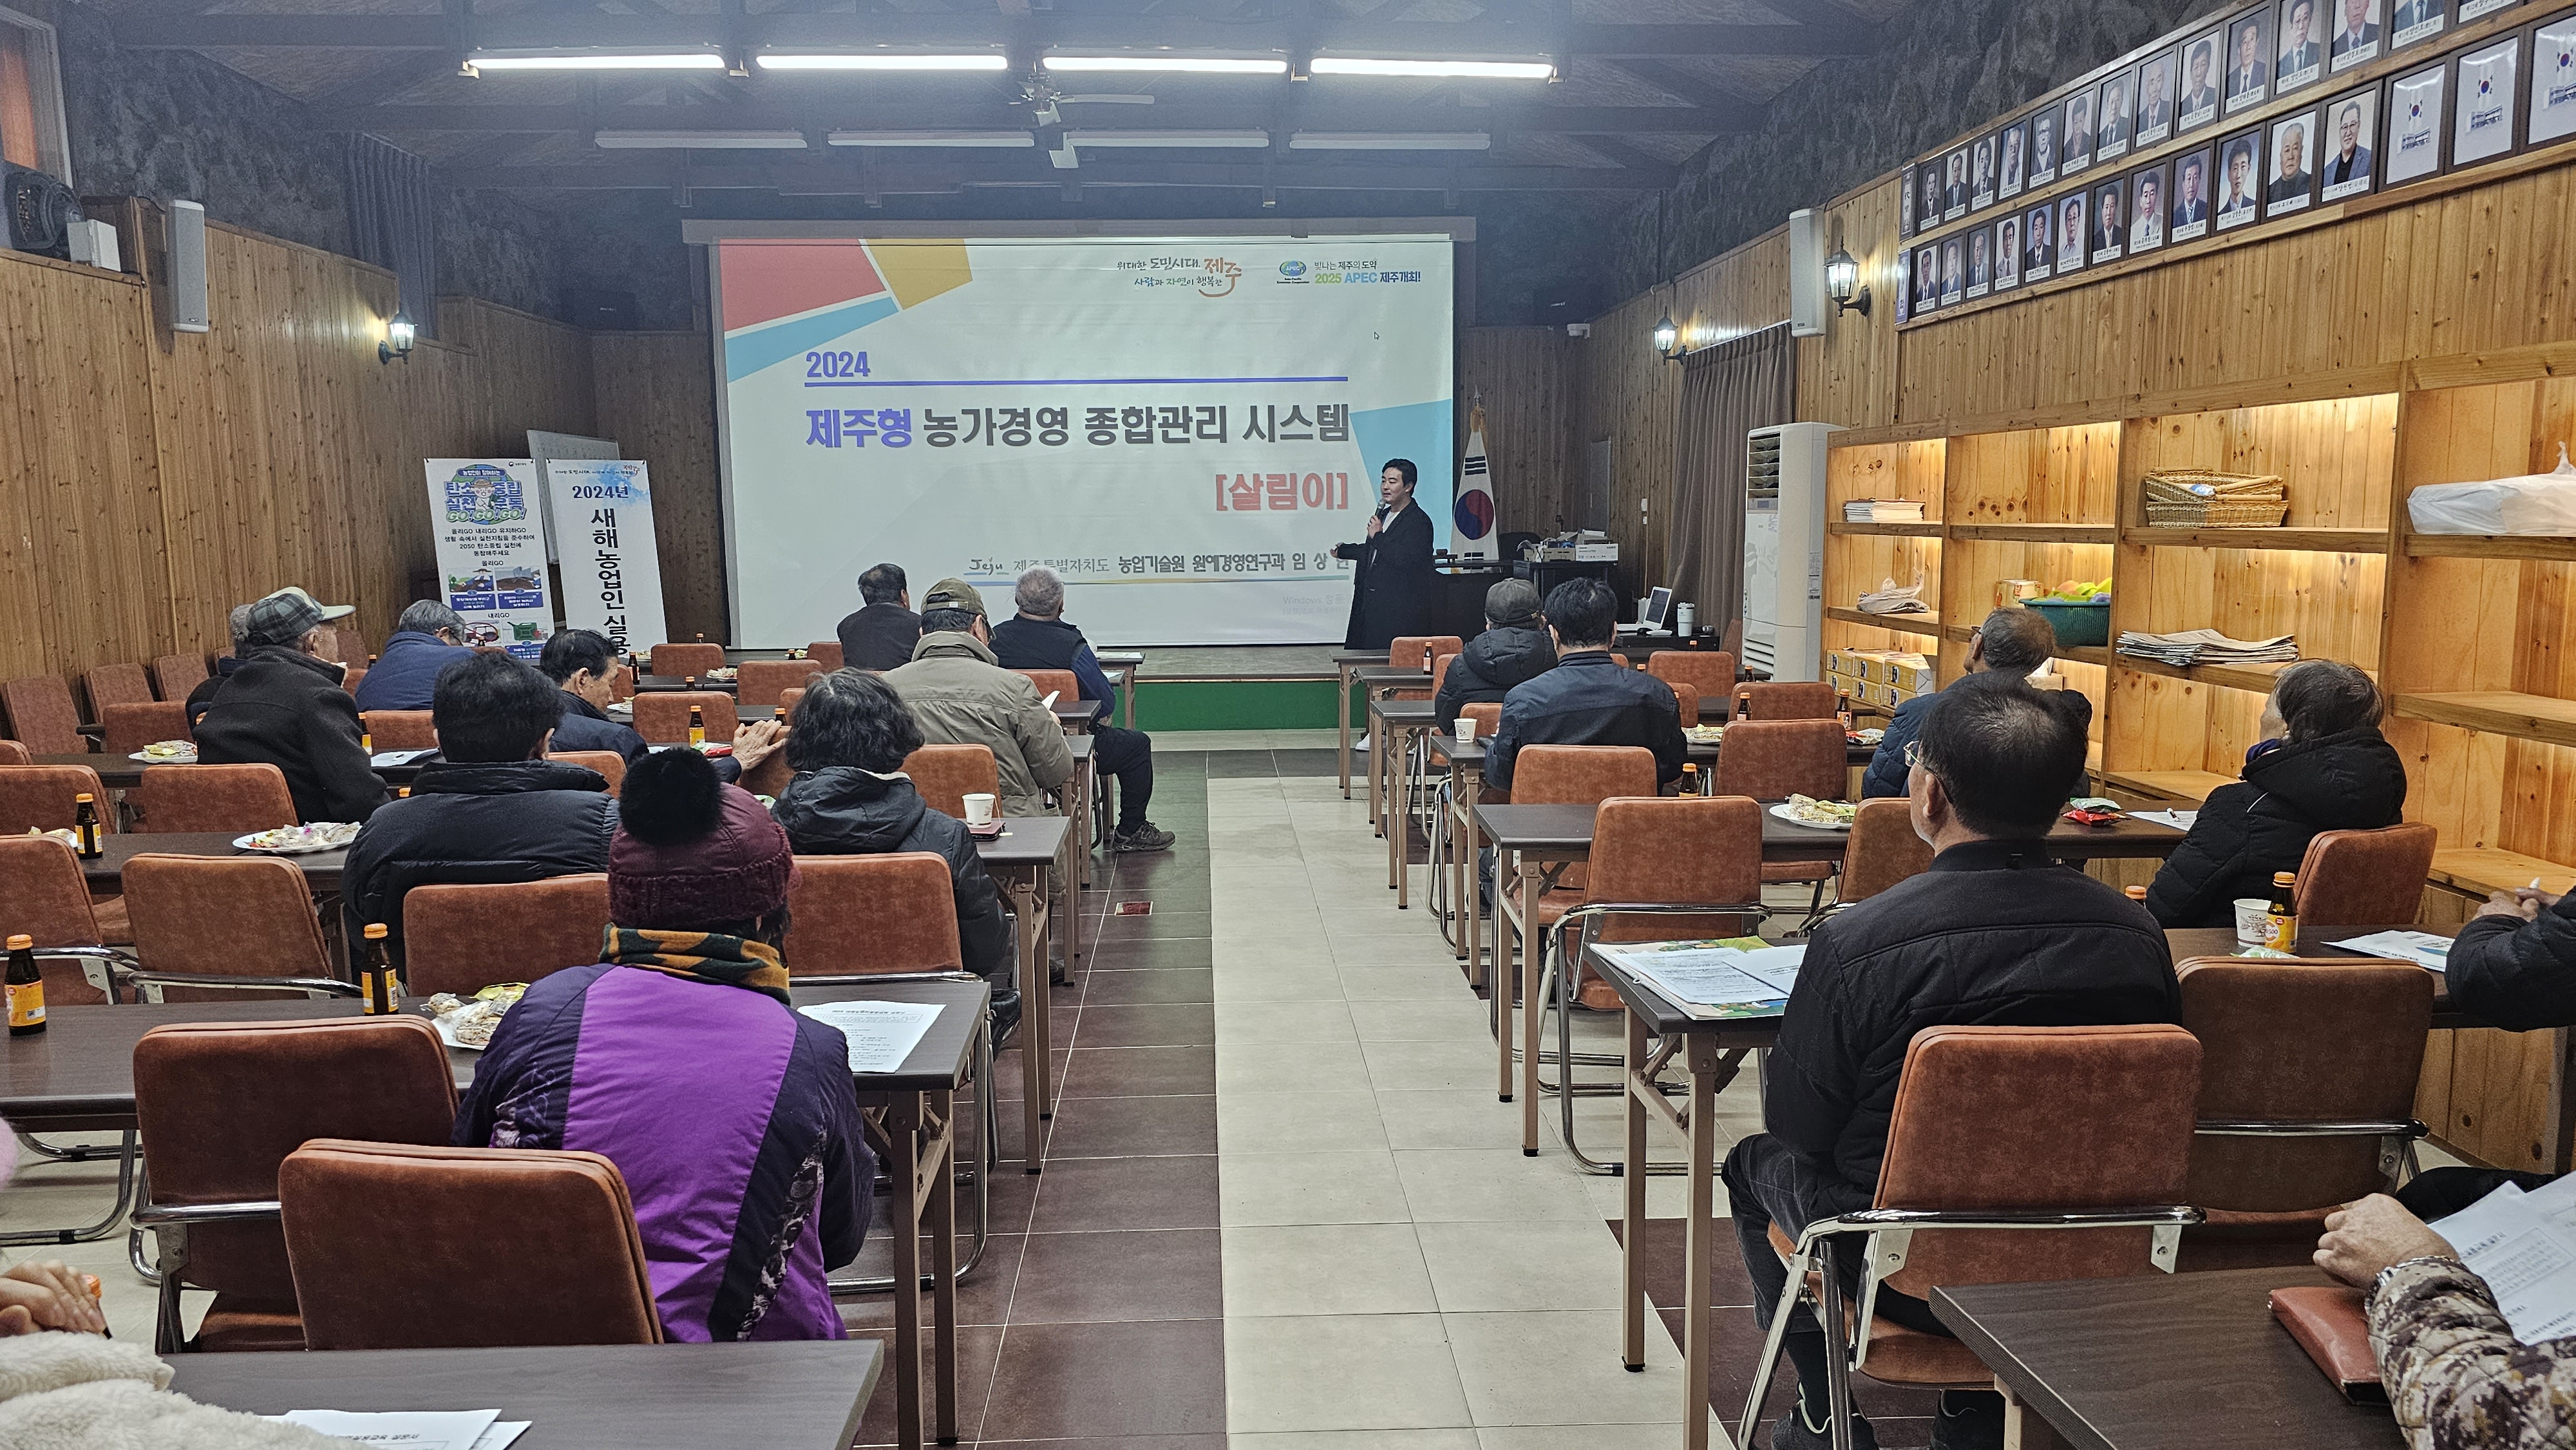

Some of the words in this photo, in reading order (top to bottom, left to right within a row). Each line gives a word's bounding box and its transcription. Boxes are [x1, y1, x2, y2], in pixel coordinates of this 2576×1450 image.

[1314, 261, 1337, 270] 빛나는
[1338, 261, 1360, 270] 제주의
[1361, 260, 1378, 270] 도약
[1117, 260, 1147, 271] 위대한
[1198, 257, 1242, 297] 제주
[1134, 277, 1164, 287] 사람과
[1166, 278, 1194, 287] 자연이
[1196, 276, 1223, 287] 행복한
[1314, 273, 1341, 284] 2025
[1344, 272, 1378, 284] APEC
[1379, 271, 1421, 283] 제주개최!
[806, 351, 871, 379] 2024
[806, 408, 913, 449] 제주형
[923, 406, 1070, 448] 농가경영
[1084, 405, 1228, 446] 종합관리
[1242, 403, 1349, 443] 시스템
[446, 482, 475, 495] 탄소
[493, 482, 522, 495] 중립
[572, 485, 629, 498] 2024년
[1215, 472, 1349, 512] [살림이]
[446, 497, 476, 511] 실천
[969, 557, 1003, 576] Jeju
[1119, 555, 1186, 574] 농업기술원
[1192, 553, 1286, 573] 원예경영연구과
[1292, 552, 1307, 571] 임
[1313, 552, 1329, 570] 상
